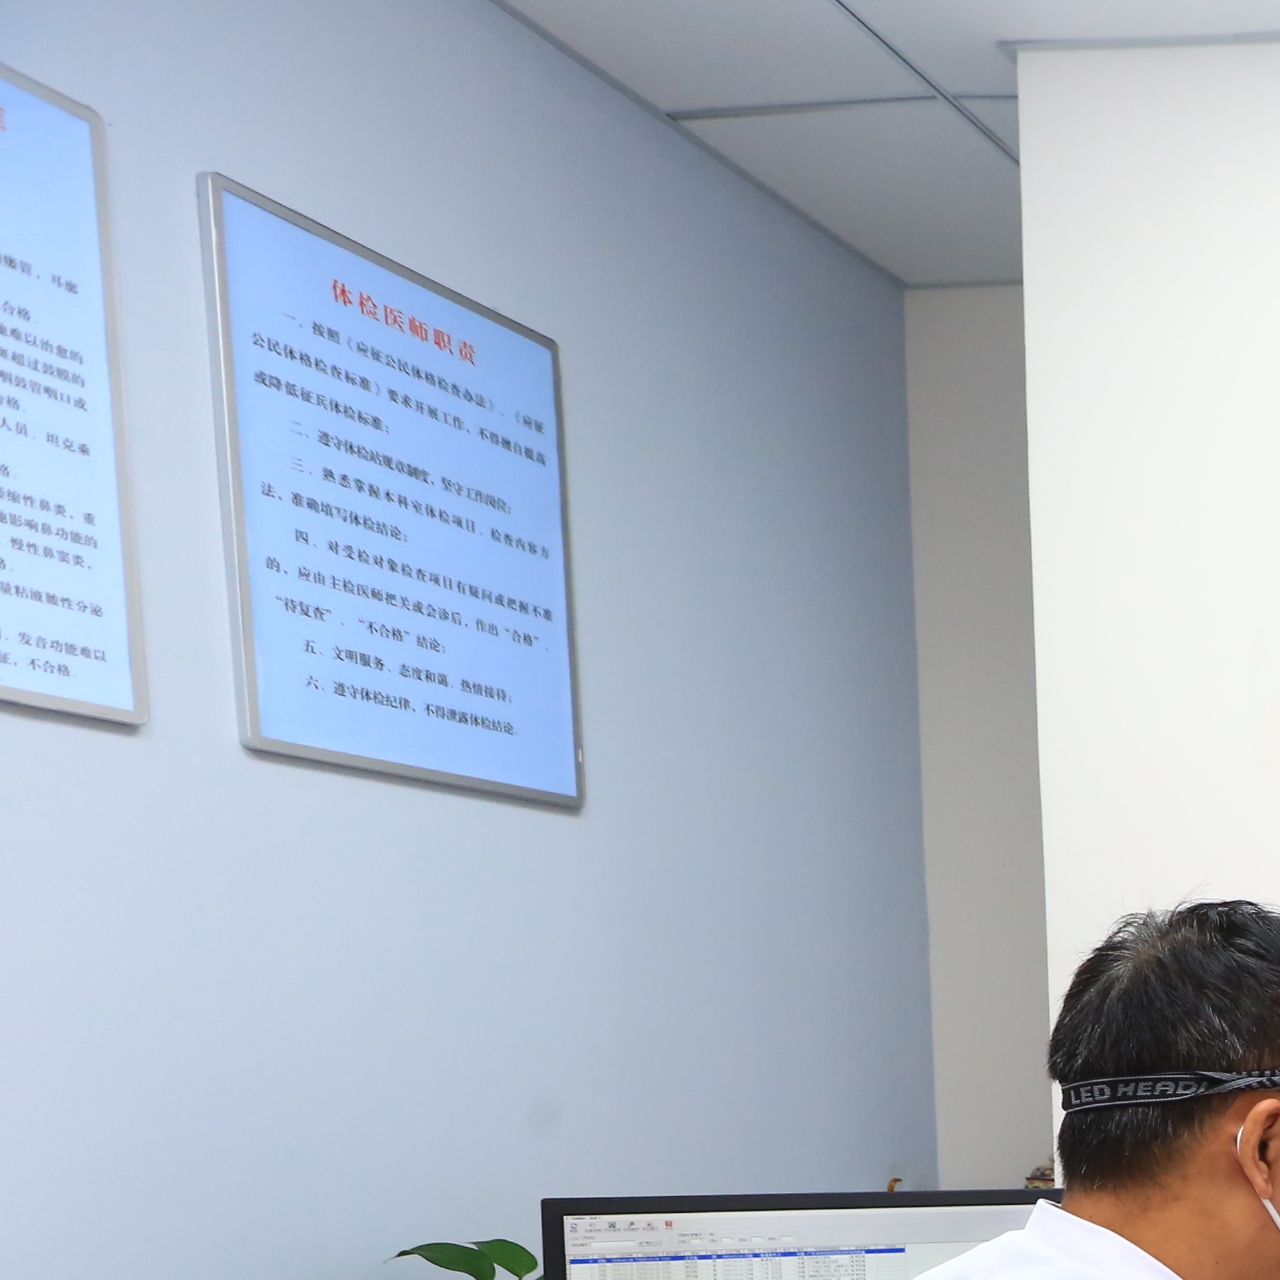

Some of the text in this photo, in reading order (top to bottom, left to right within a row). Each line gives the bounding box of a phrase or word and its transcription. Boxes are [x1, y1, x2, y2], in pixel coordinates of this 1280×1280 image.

[331, 278, 476, 366] 体检医师职责
[1069, 1084, 1112, 1106] LED
